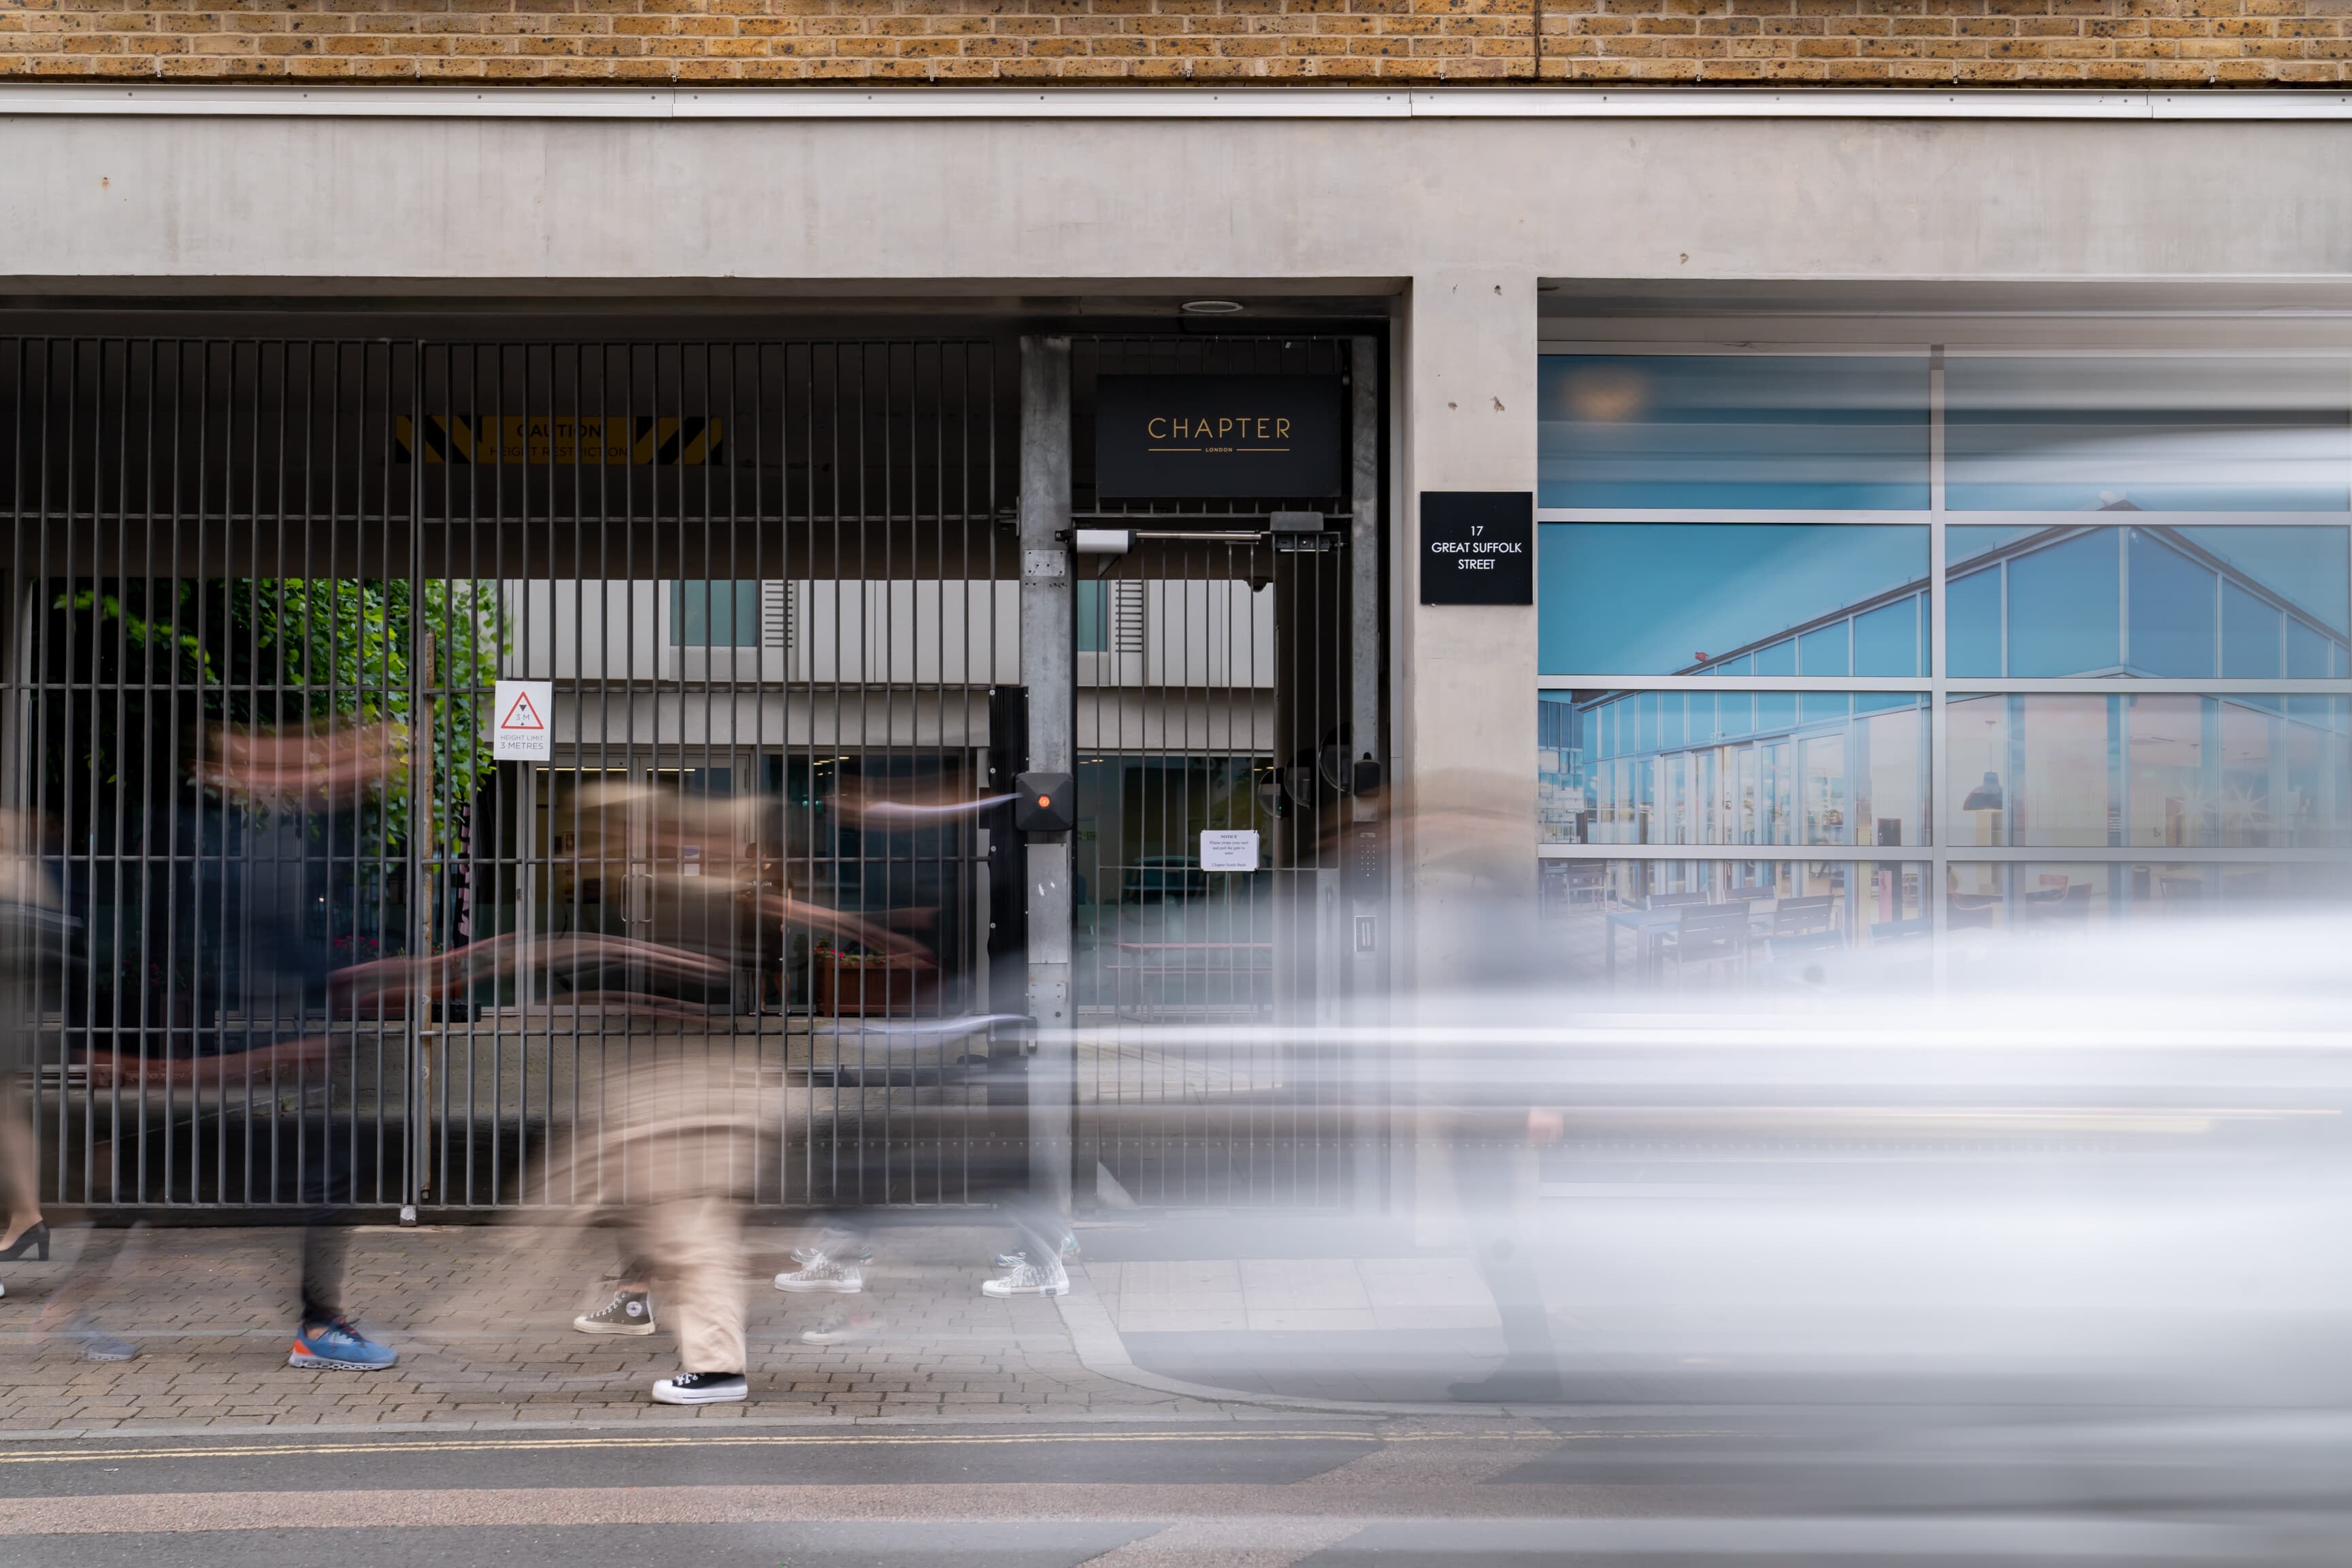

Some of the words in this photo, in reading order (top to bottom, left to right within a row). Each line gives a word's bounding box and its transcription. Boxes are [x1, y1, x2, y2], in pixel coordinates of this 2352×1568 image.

[1148, 418, 1290, 439] CHAPTER
[1471, 526, 1484, 536] 17
[1431, 542, 1470, 553] GREAT
[1472, 542, 1522, 553] SUFFOLK
[1458, 559, 1495, 569] STREET
